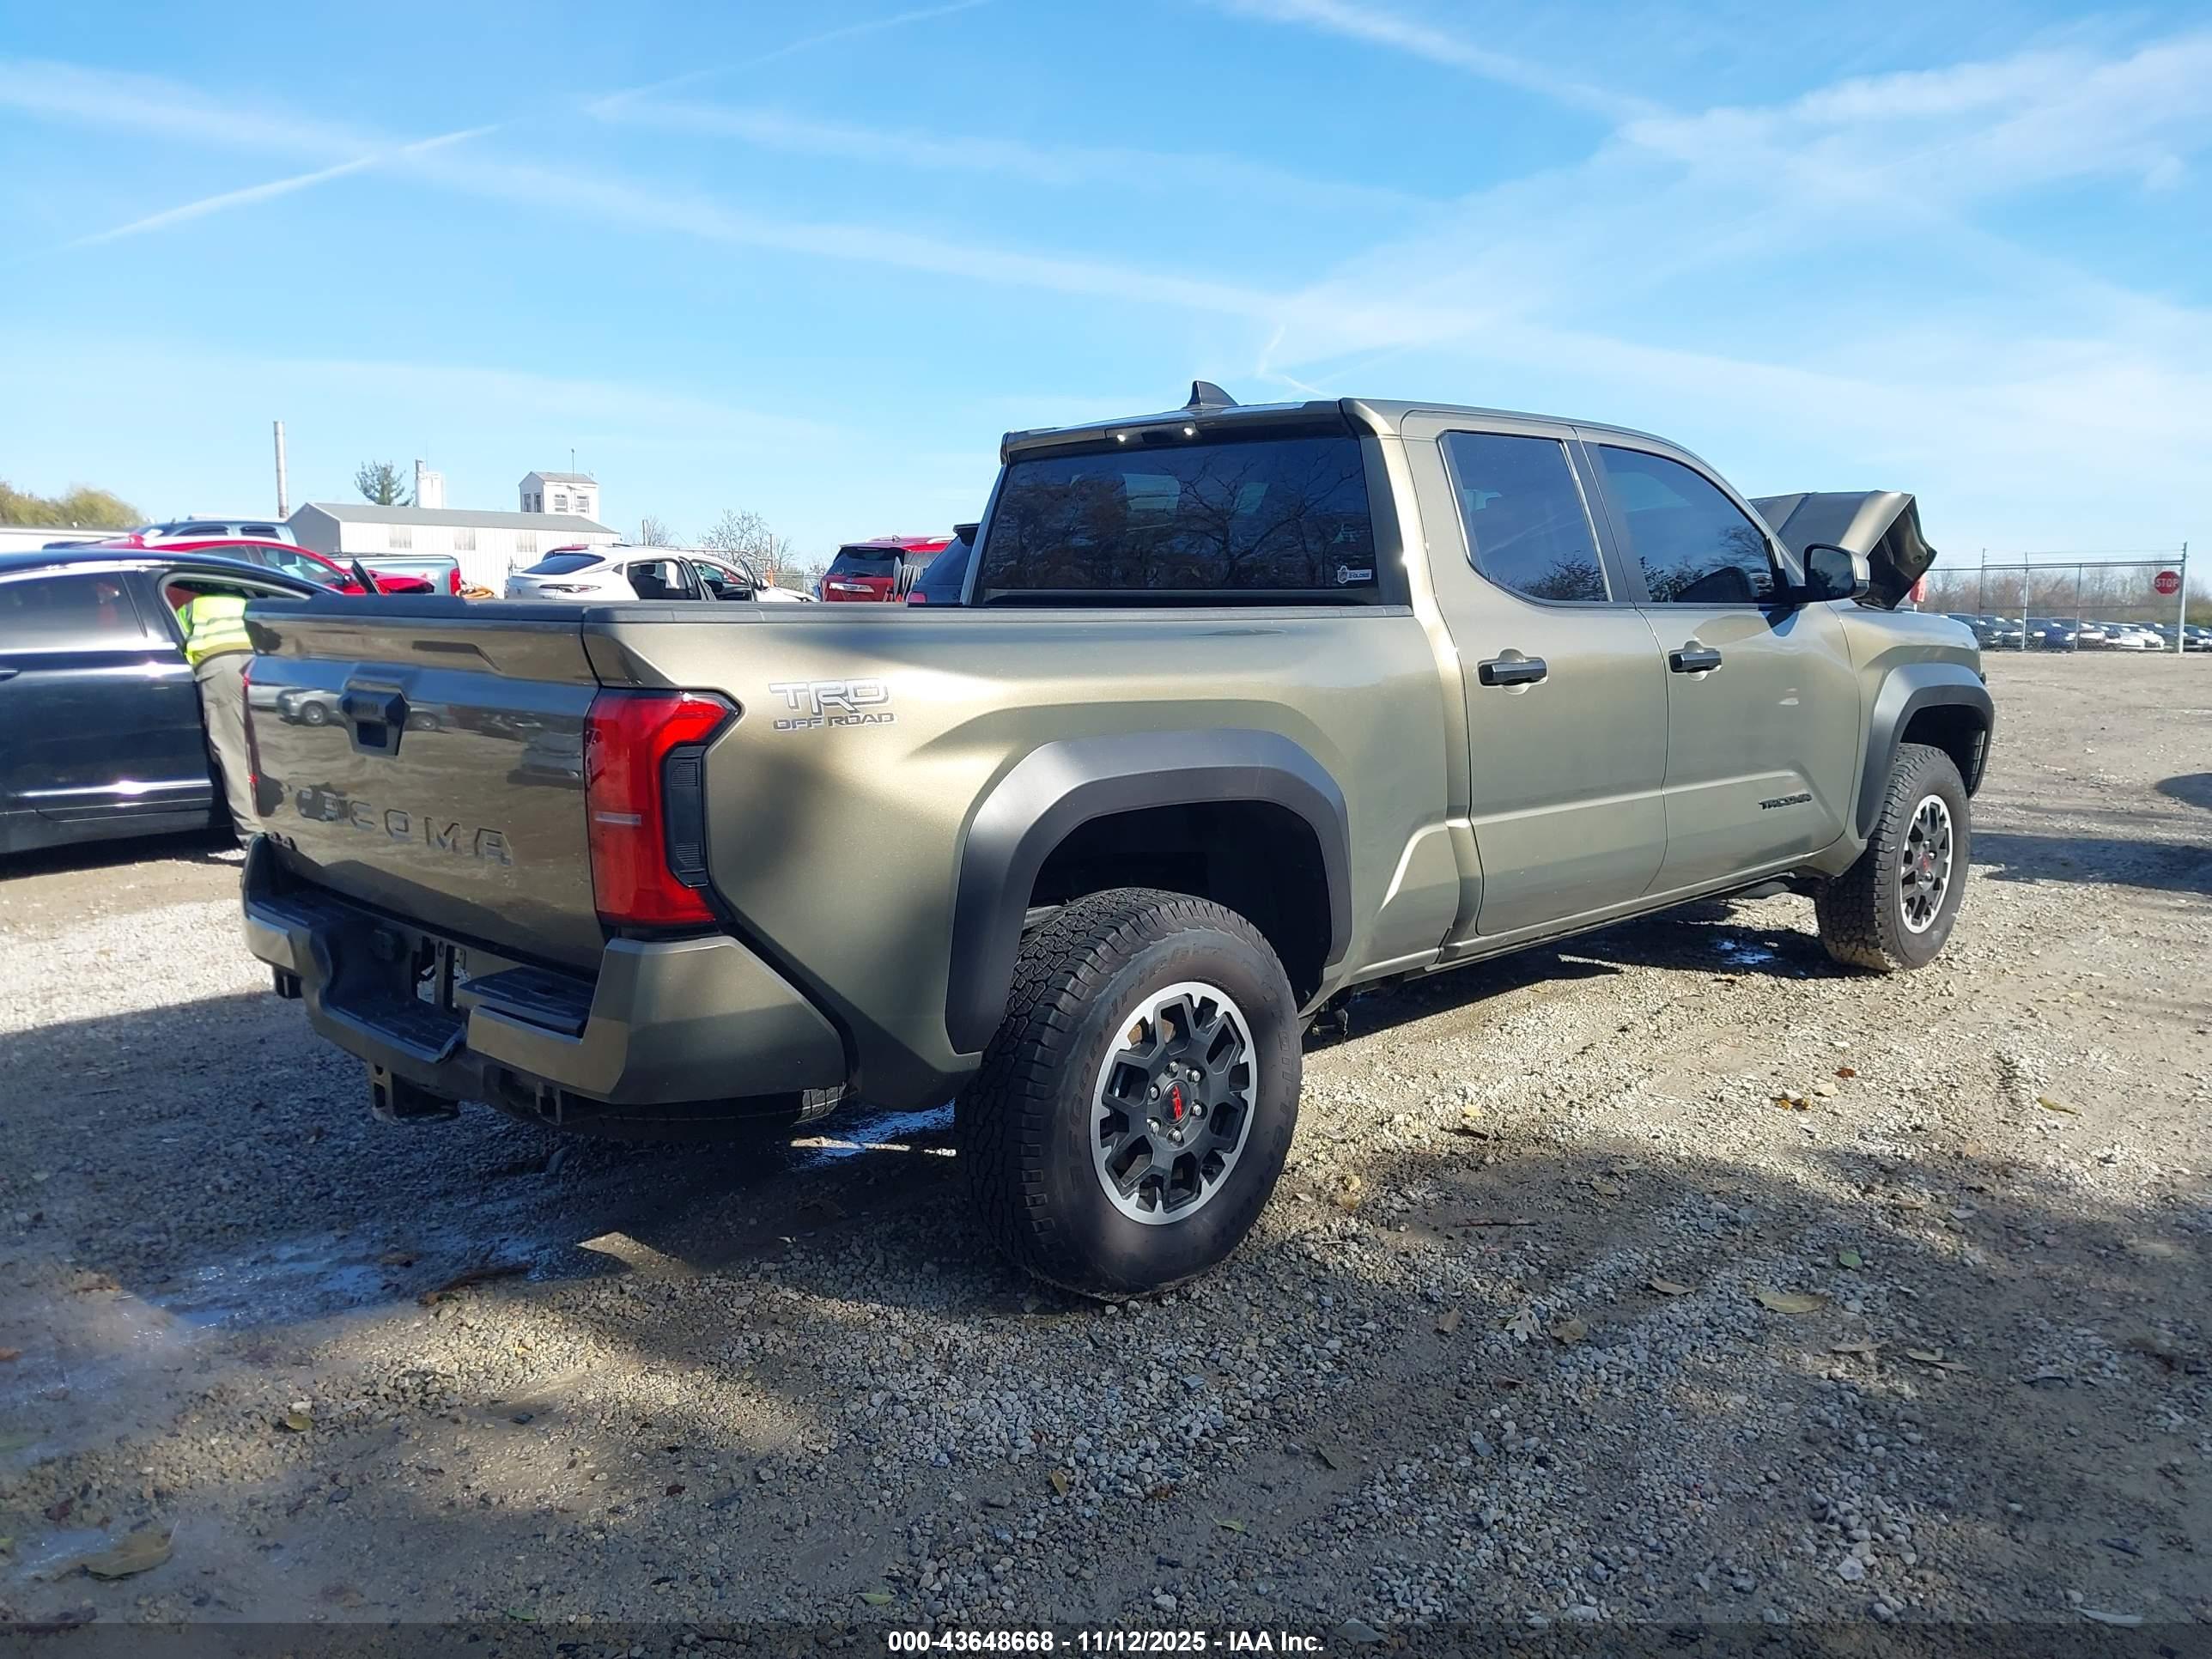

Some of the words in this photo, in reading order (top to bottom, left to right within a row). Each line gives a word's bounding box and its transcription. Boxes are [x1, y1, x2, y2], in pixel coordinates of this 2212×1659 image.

[2155, 578, 2179, 587] STOP
[769, 678, 890, 715] TRD
[773, 717, 822, 730] OFF
[827, 712, 895, 727] ROAD
